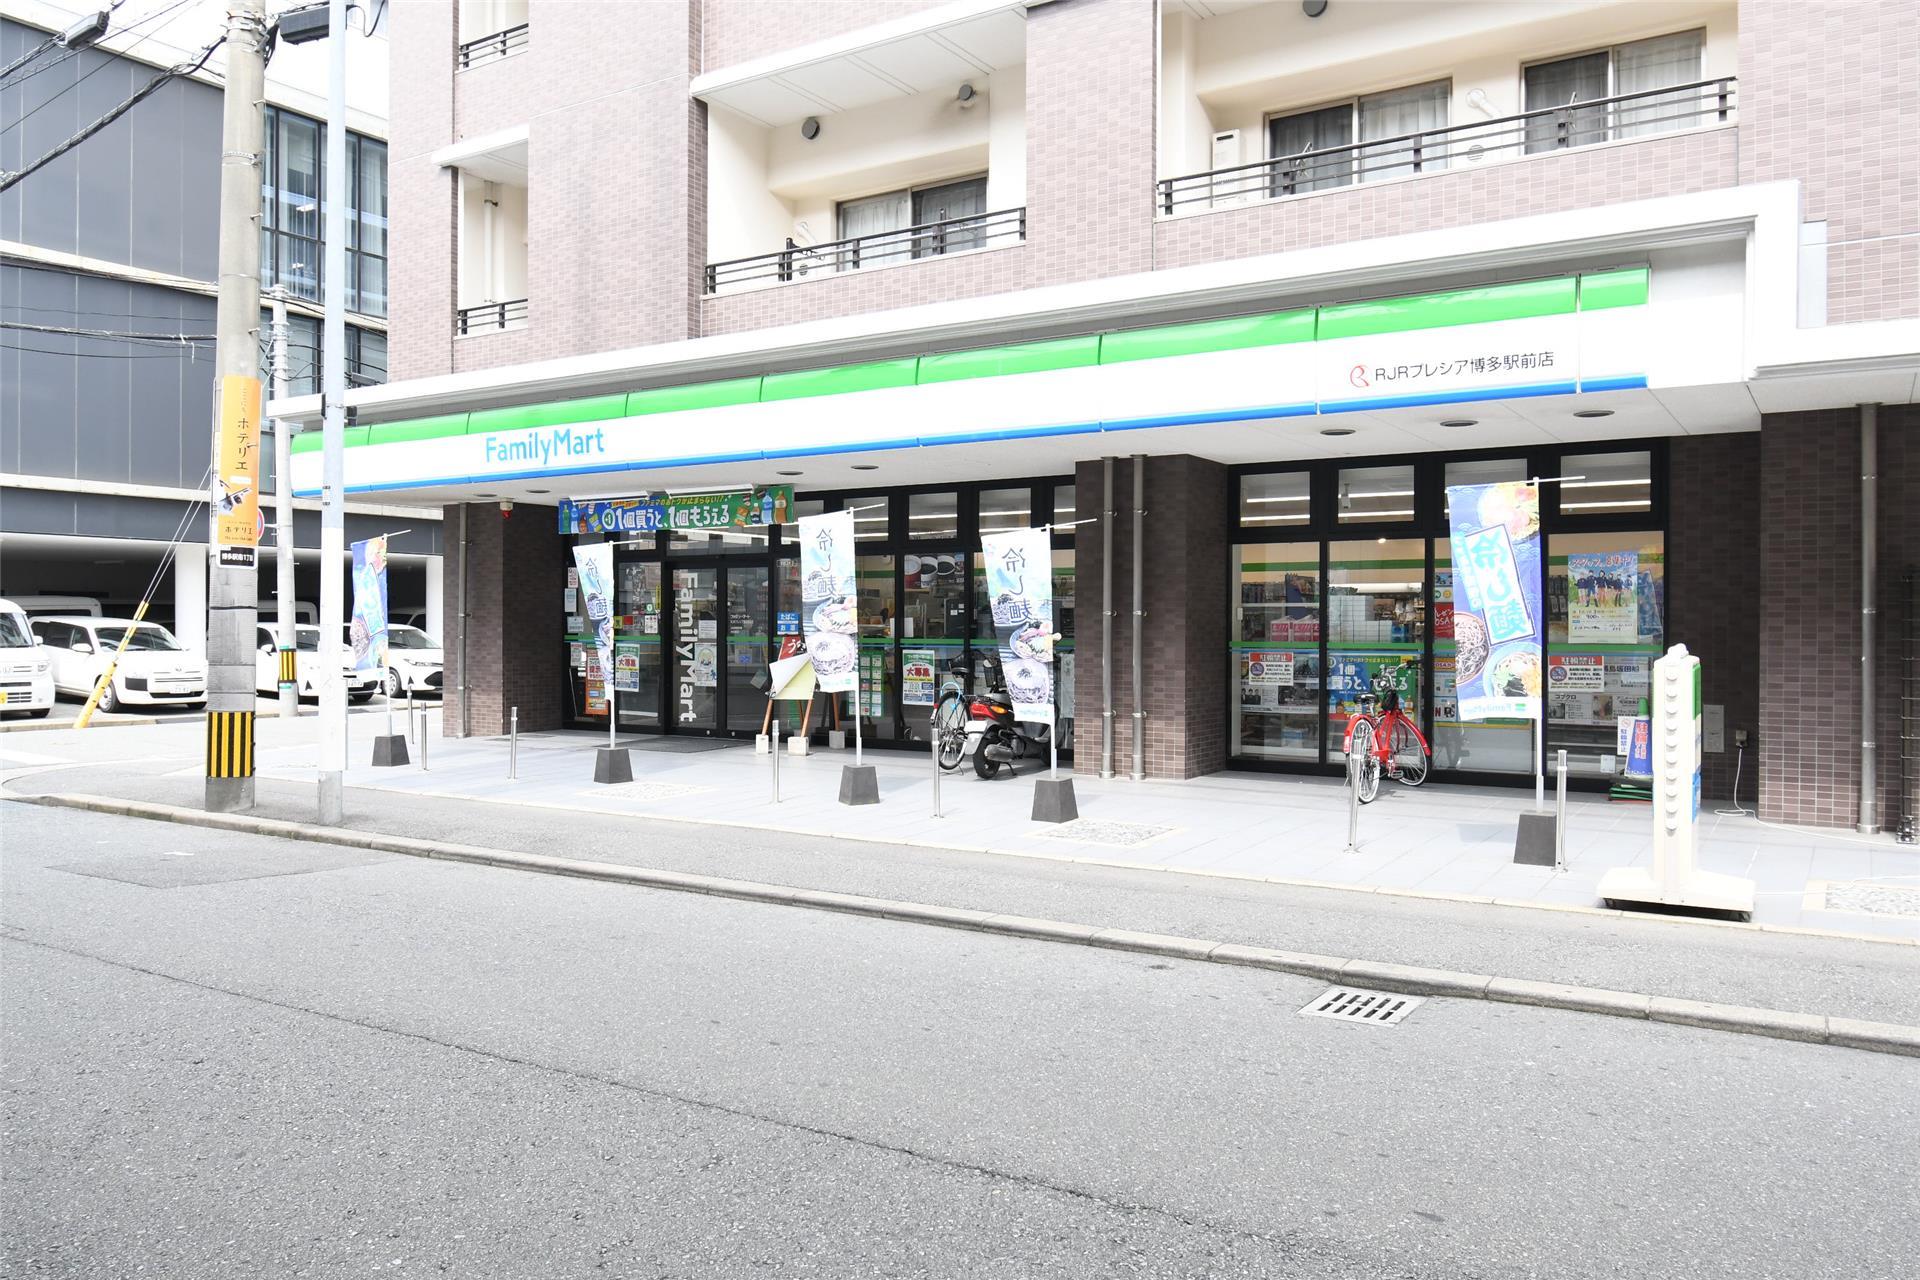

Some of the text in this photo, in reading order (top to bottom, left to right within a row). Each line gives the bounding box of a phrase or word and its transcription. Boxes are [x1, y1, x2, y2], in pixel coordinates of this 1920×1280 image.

[1375, 352, 1554, 381] RJRプレシア博多駅前店
[235, 417, 249, 470] ホテリエ
[486, 428, 604, 465] FamilyMart
[615, 505, 730, 529] 1個買うと、1個もらえる
[675, 572, 698, 722] FamilyMart
[1561, 657, 1596, 665] 駐輪禁止
